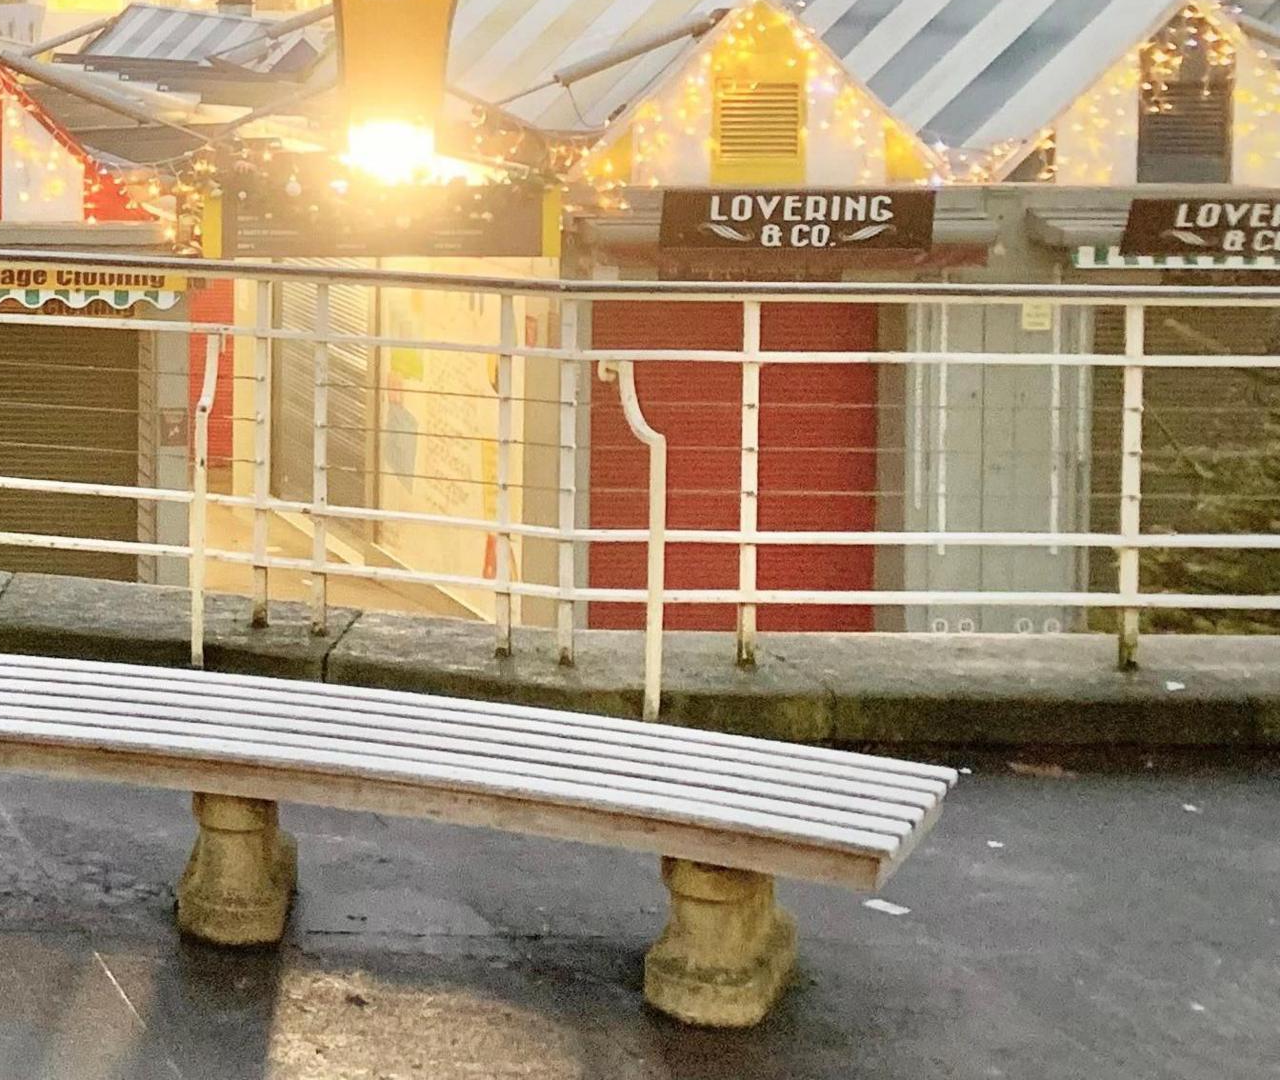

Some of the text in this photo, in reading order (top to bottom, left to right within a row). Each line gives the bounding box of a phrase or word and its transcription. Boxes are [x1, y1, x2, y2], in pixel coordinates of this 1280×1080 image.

[710, 195, 895, 222] LOVERING
[761, 224, 838, 248] & CO.
[1223, 230, 1247, 252] &
